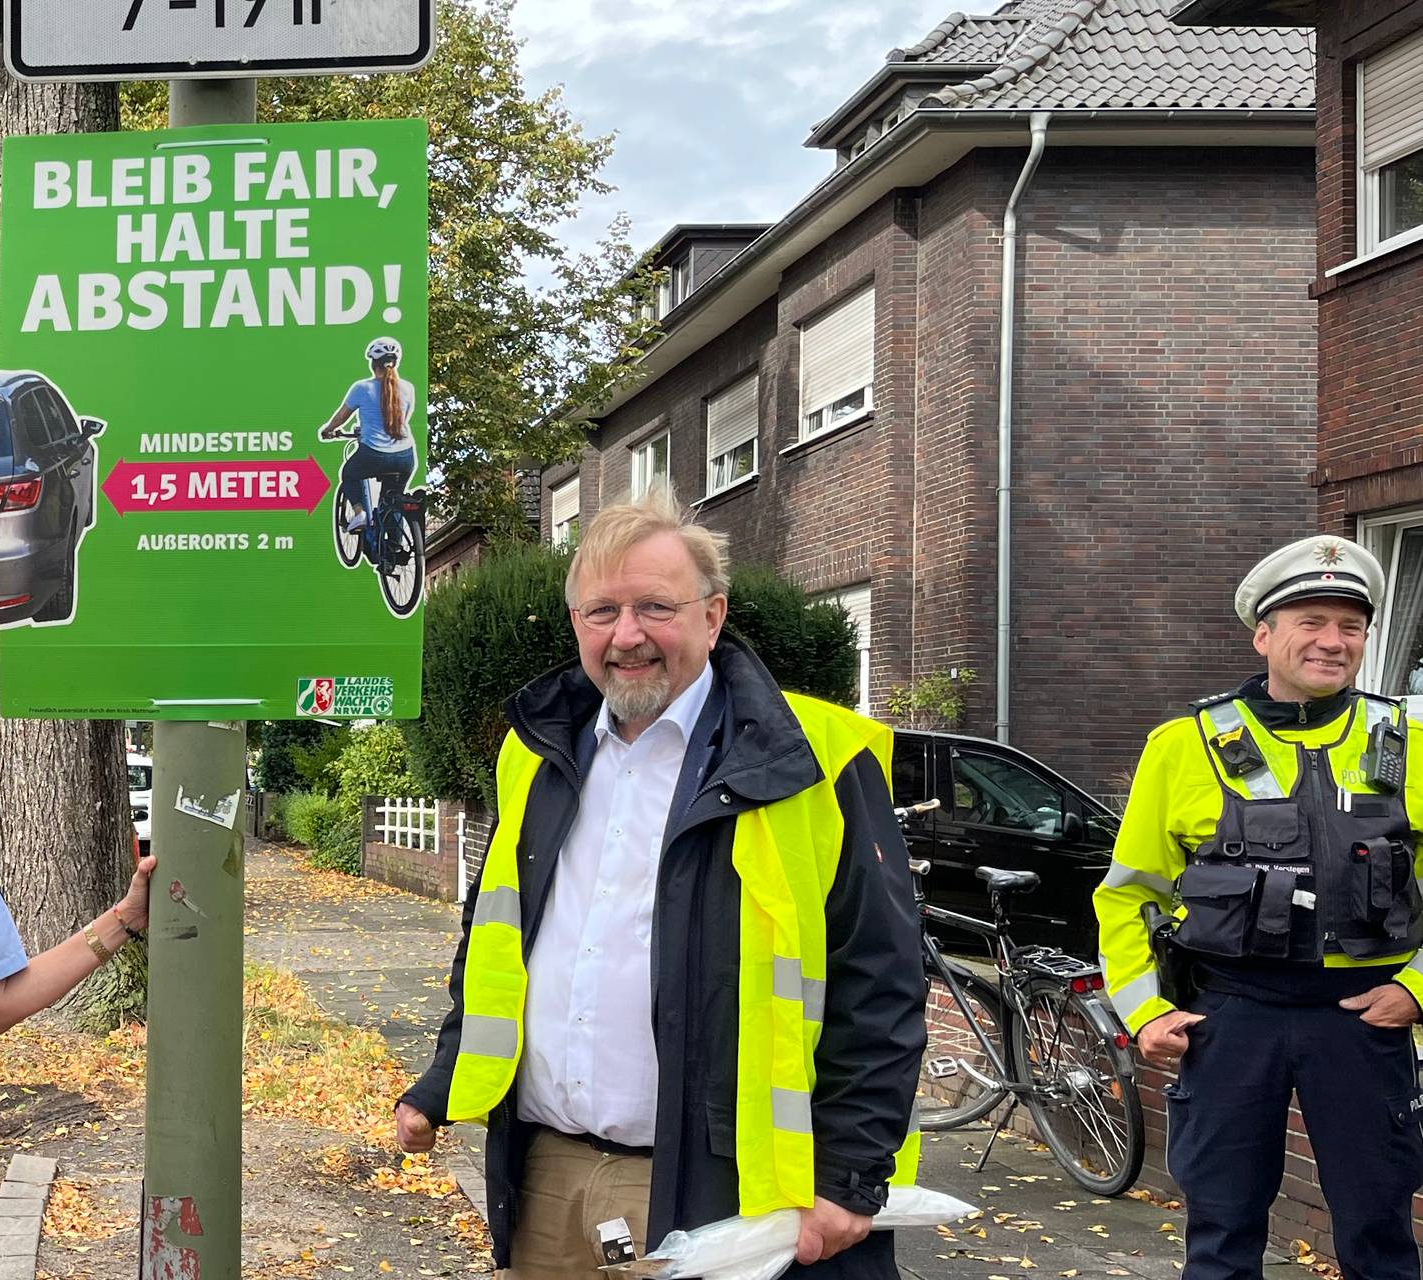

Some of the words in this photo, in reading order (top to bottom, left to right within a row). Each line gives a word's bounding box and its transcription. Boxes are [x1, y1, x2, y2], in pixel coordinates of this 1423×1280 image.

[33, 154, 212, 209] BLEIB
[234, 148, 398, 209] FAIR,
[116, 208, 310, 263] HALTE
[20, 264, 403, 333] ABSTAND!
[139, 431, 293, 453] MINDESTENS
[130, 473, 177, 506] 1,5
[187, 471, 300, 499] METER
[136, 534, 250, 551] AUßERORTS
[257, 533, 269, 549] 2
[274, 536, 294, 549] m
[334, 685, 393, 696] VERKEHRS
[346, 677, 393, 686] LANDES
[334, 696, 374, 707] WACHT
[334, 706, 361, 715] NRW
